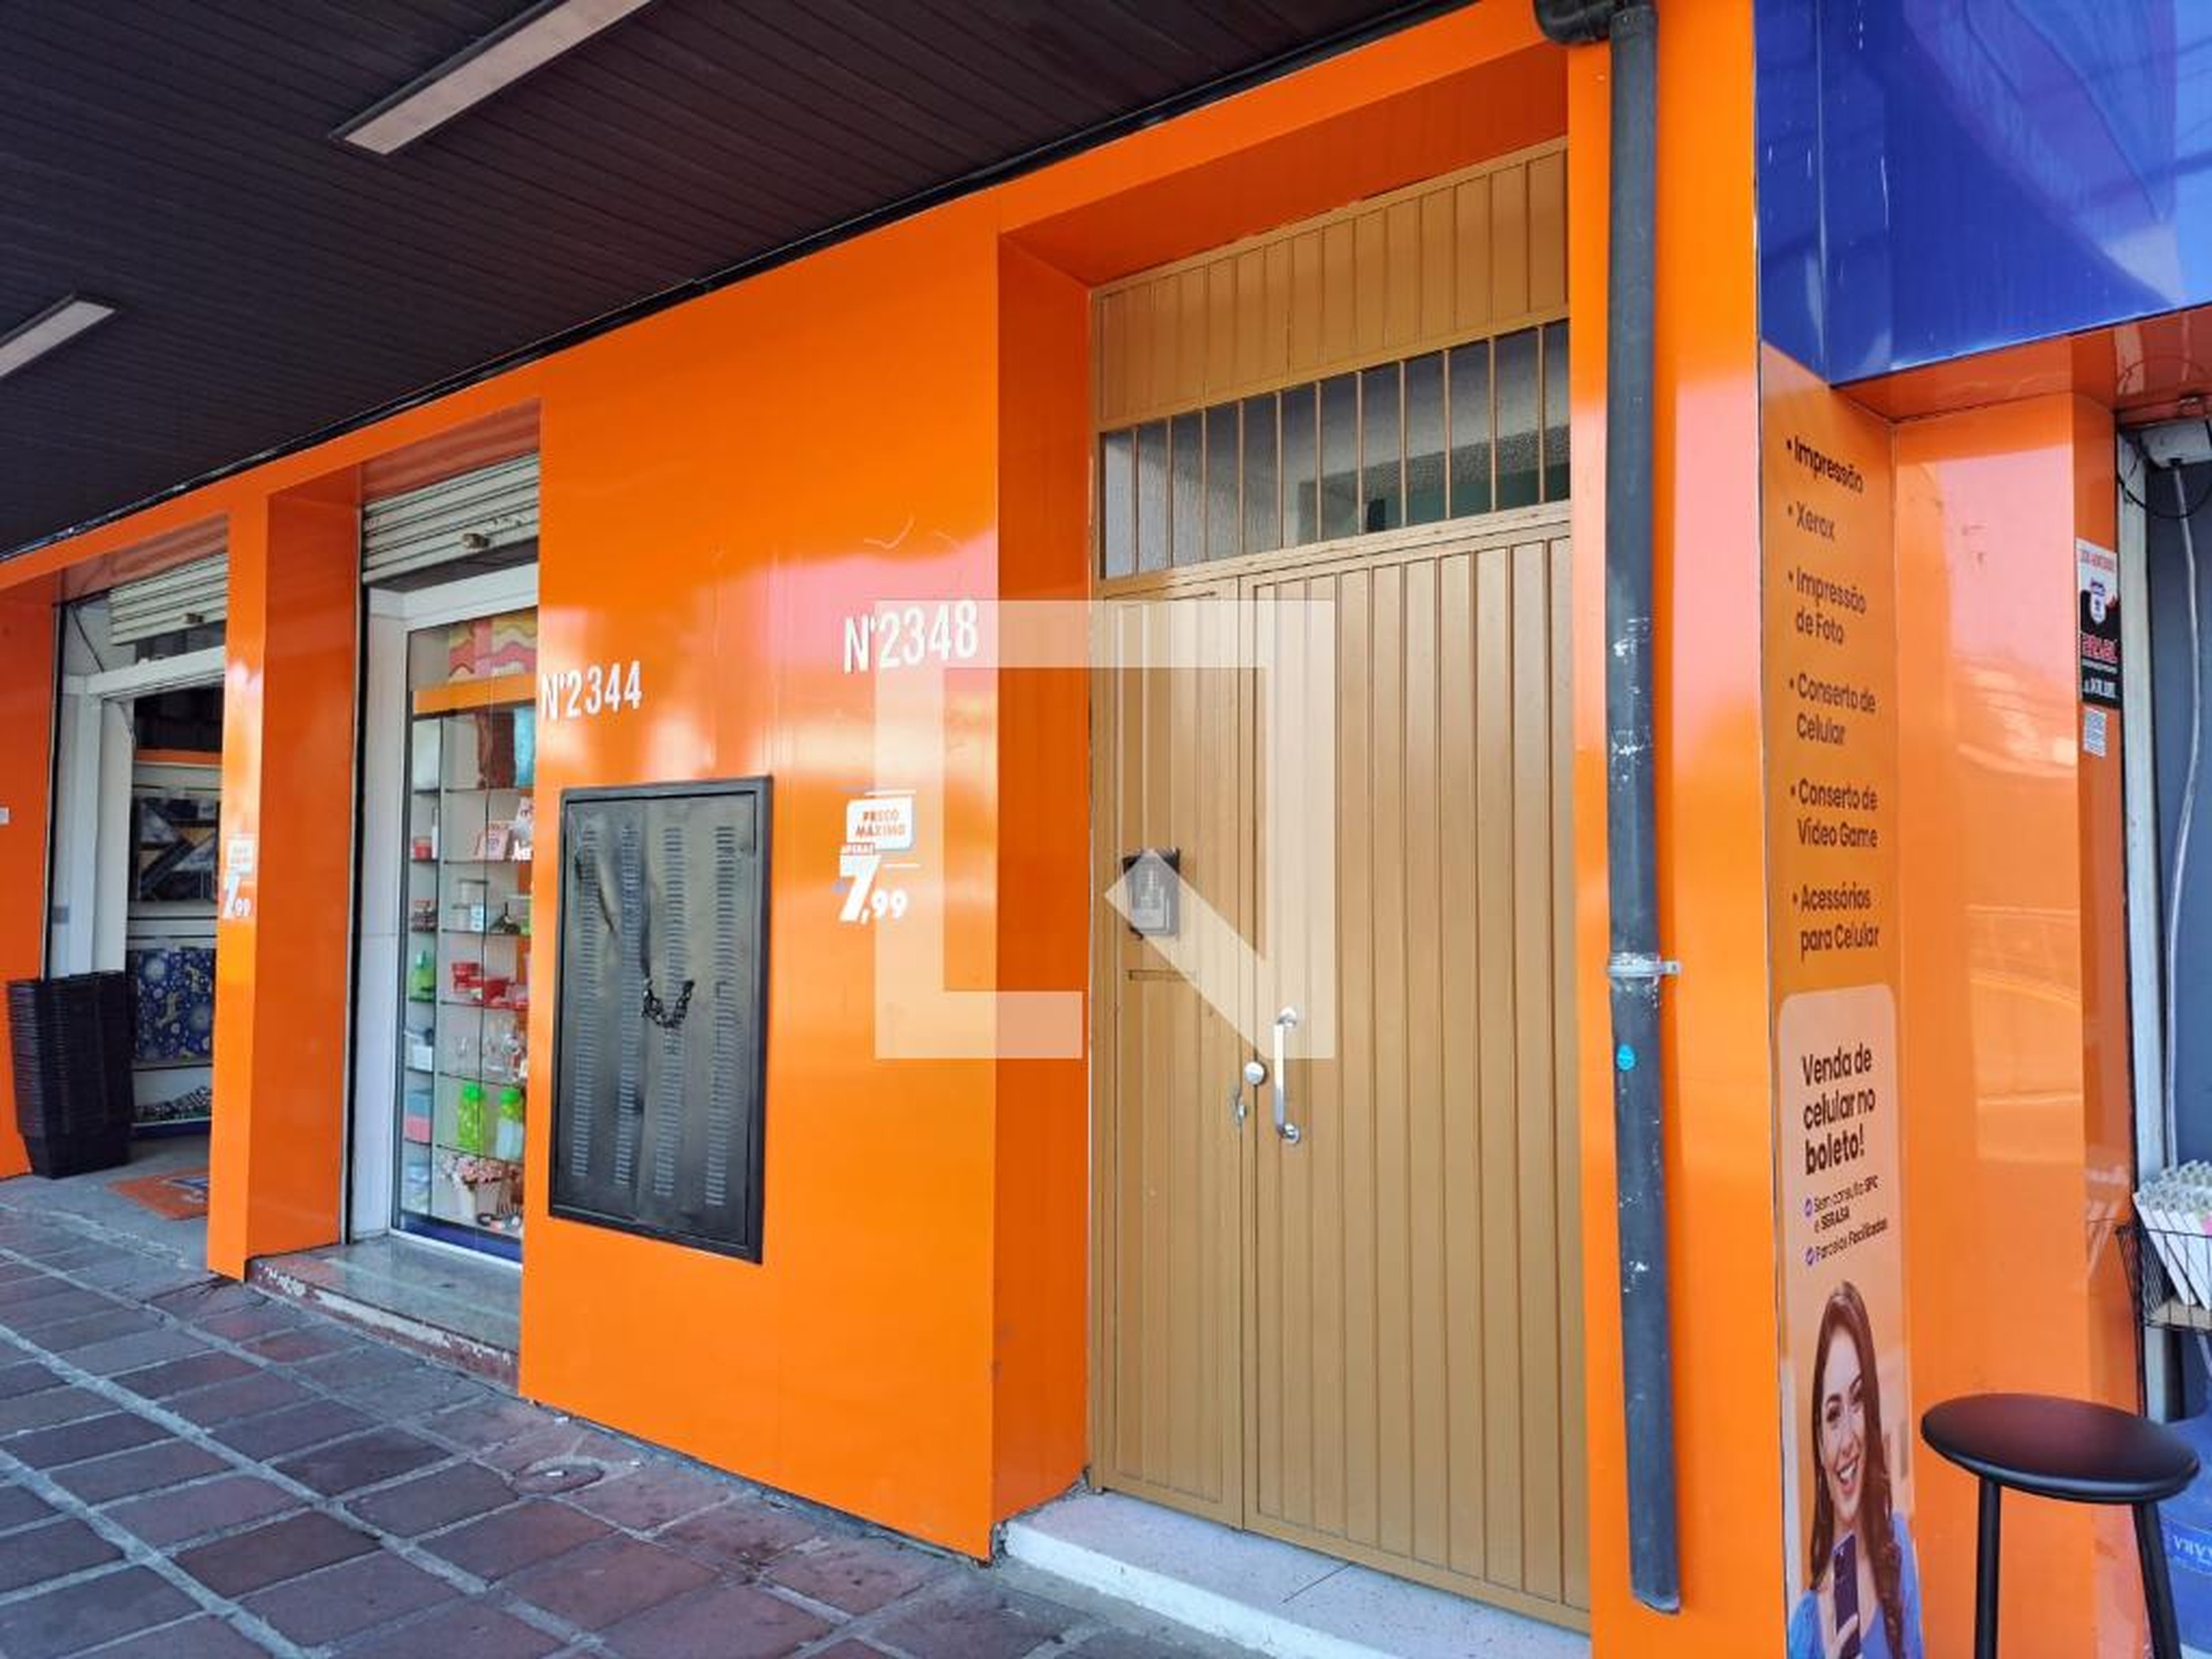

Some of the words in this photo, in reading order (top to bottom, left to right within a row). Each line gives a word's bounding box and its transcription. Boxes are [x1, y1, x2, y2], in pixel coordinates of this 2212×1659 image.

[1794, 437, 1863, 494] Impressão
[1797, 501, 1835, 541] Xerox
[1796, 567, 1867, 615] Impressão
[1796, 607, 1814, 635] de
[1816, 612, 1844, 645] Foto
[1798, 672, 1858, 711] Conserto
[1859, 689, 1876, 714] de
[1797, 713, 1846, 746] Celular
[1798, 778, 1860, 809] Conserto
[1862, 785, 1878, 812] de
[1840, 821, 1878, 848] Game
[840, 854, 907, 925] 7,99
[1801, 881, 1871, 912] Acessórios
[1801, 926, 1832, 963] para
[1835, 923, 1879, 950] Celular
[1802, 1046, 1853, 1086] Venda
[1854, 1042, 1873, 1074] de
[1803, 1089, 1855, 1131] celular
[1857, 1088, 1876, 1116] no
[1805, 1123, 1865, 1176] boleto!
